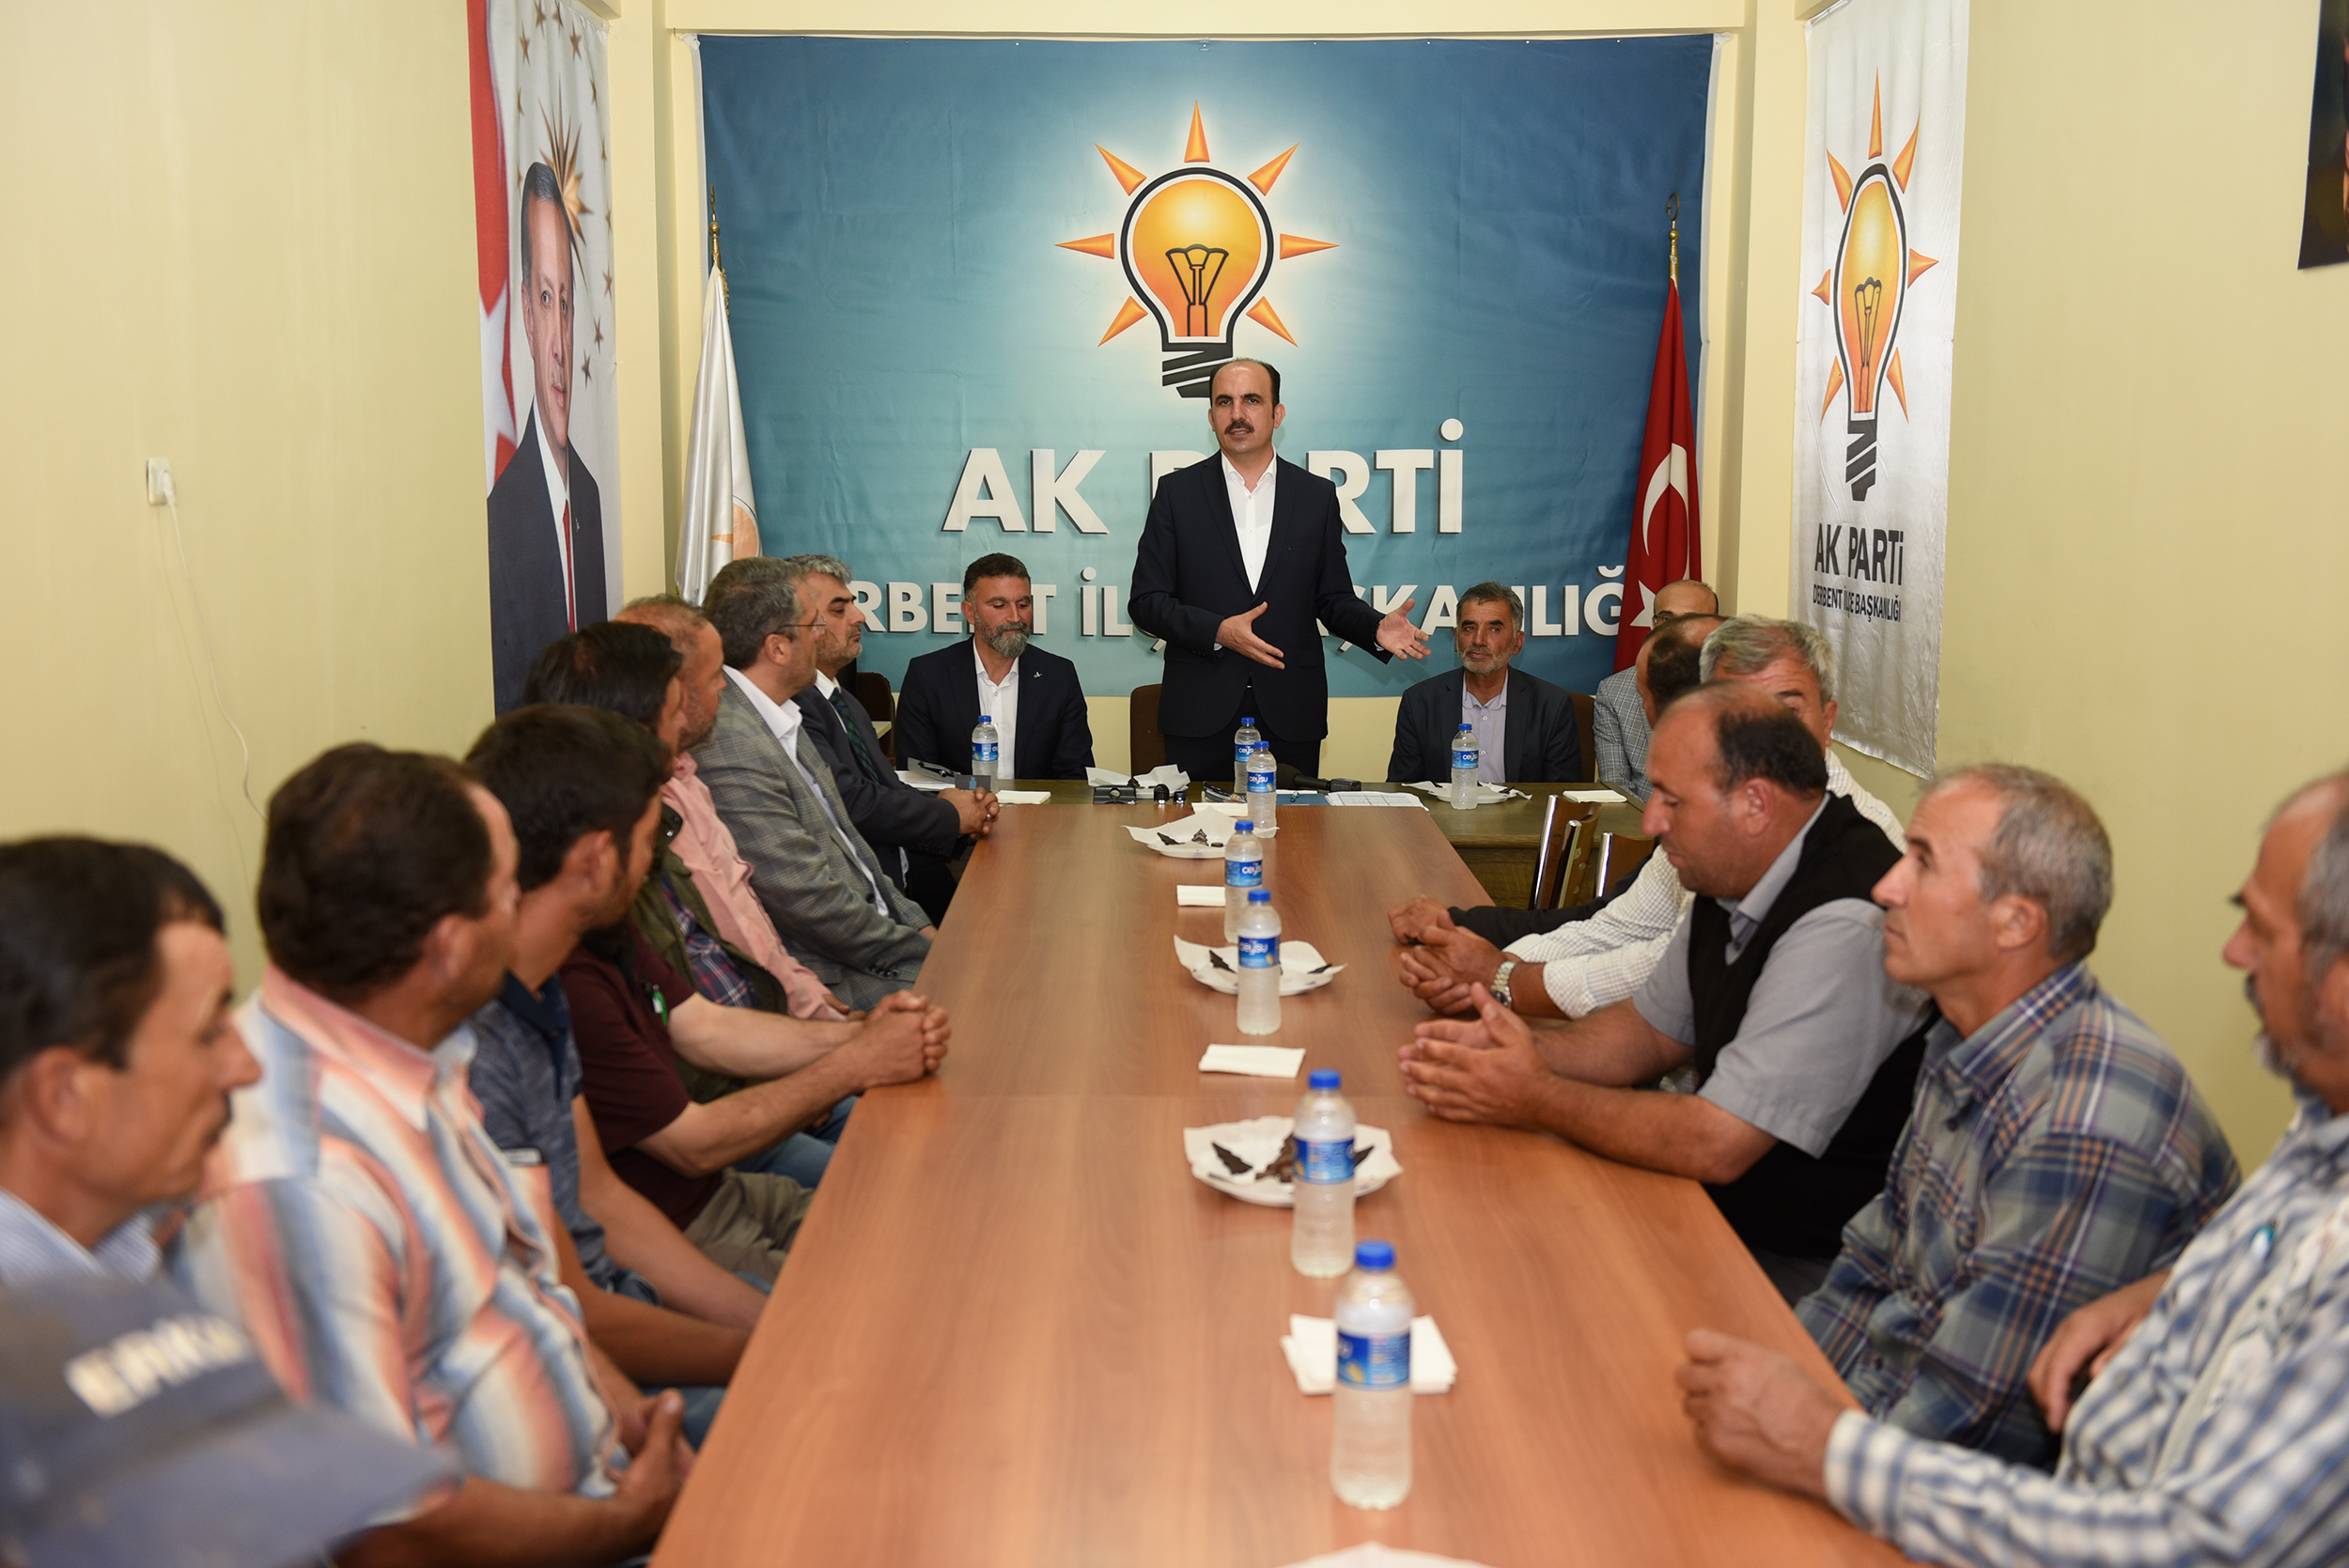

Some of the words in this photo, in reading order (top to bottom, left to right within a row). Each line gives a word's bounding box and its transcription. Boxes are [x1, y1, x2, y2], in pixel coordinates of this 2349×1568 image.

[941, 447, 1111, 535] AK
[1149, 418, 1464, 535] RTİ
[1814, 522, 1843, 576] AK
[1846, 526, 1905, 586] PARTİ
[1812, 583, 1843, 610] DERBENT
[1855, 593, 1902, 623] BAŞKANLIĞI
